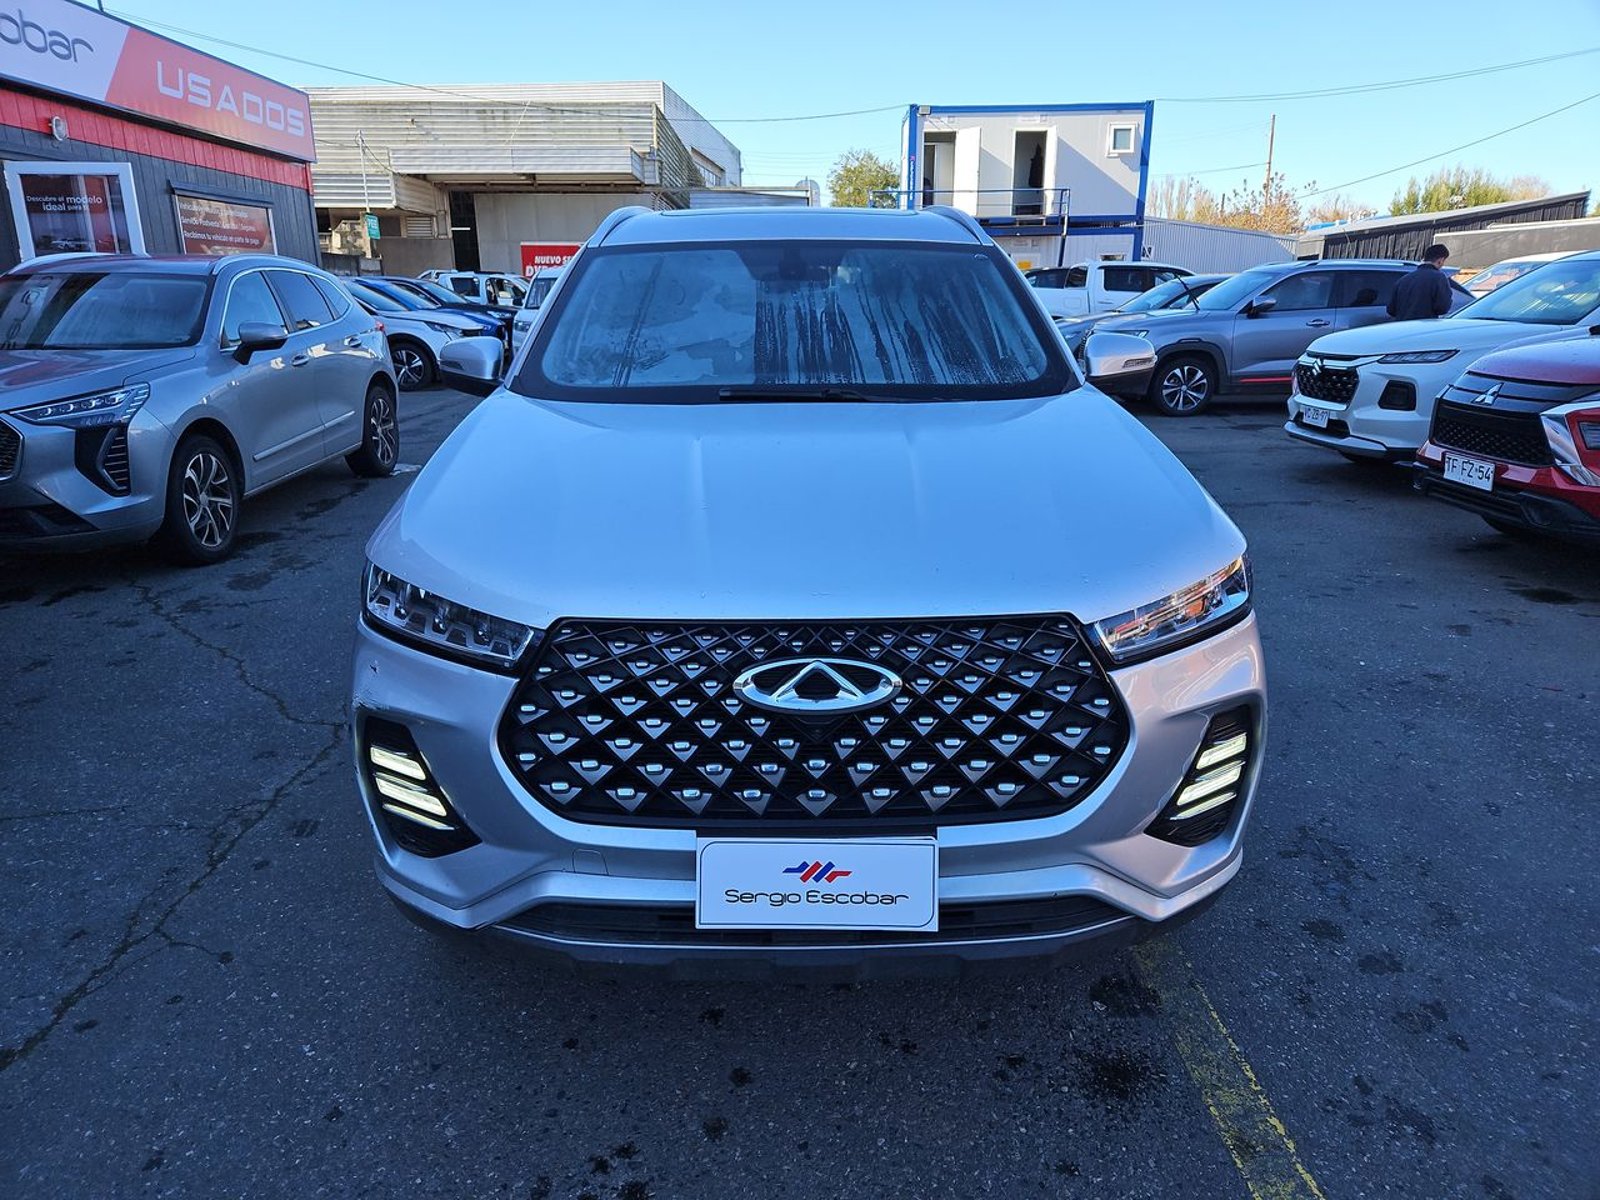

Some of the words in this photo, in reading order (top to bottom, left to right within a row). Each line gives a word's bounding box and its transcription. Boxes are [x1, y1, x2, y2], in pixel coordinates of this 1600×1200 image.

[156, 60, 305, 137] USADOS
[66, 195, 103, 205] modelo
[43, 203, 66, 211] ideal
[535, 255, 561, 264] NUEVO
[724, 889, 802, 907] Sergio
[806, 889, 909, 906] Escobar
